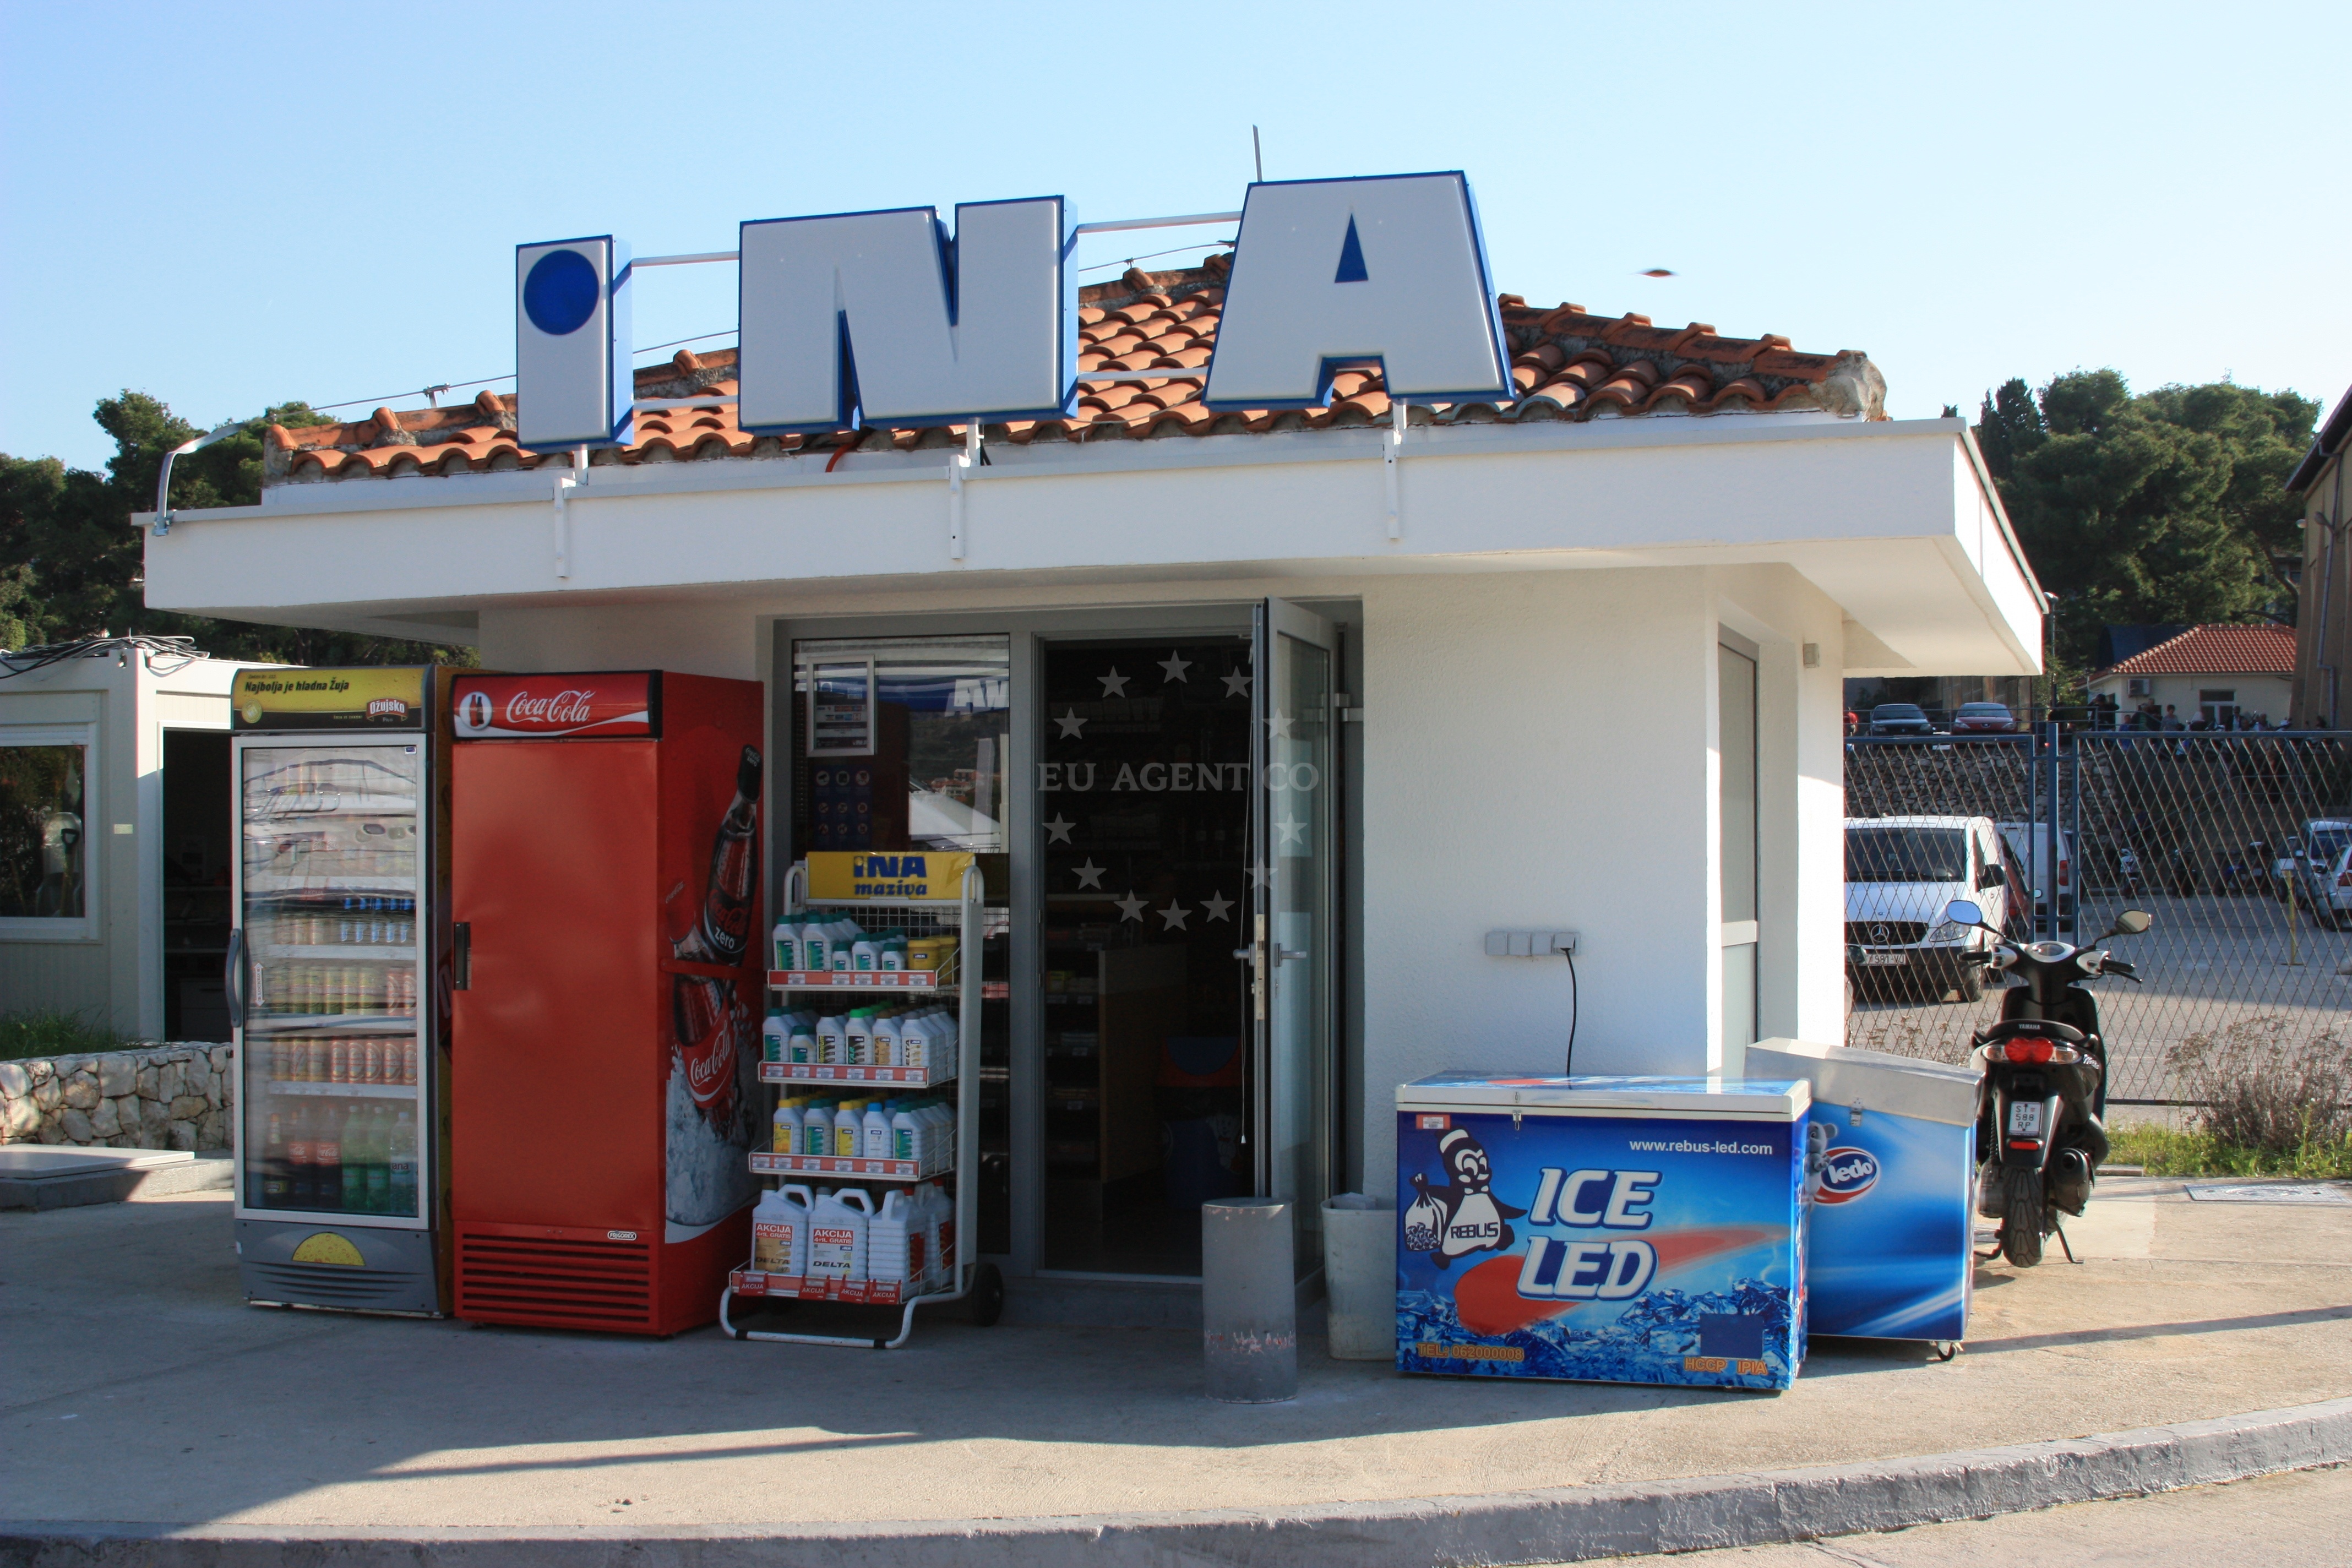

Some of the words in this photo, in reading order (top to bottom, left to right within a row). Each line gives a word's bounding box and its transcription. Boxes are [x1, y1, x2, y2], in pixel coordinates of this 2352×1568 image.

[245, 681, 283, 694] Najbolja
[283, 681, 293, 694] je
[296, 680, 328, 690] hladna
[329, 677, 350, 692] Žuja
[369, 700, 405, 714] Ožujsko
[506, 690, 596, 723] Coca-Cola
[854, 880, 927, 896] maziva
[708, 888, 747, 936] Coca-Cola
[715, 926, 736, 950] zero
[690, 1019, 731, 1088] Coca-Cola
[1629, 1138, 1773, 1155] www.rebus-led.com
[1827, 1159, 1874, 1184] ledo
[1528, 1167, 1663, 1229] ICE
[756, 1224, 792, 1234] AKCIJA
[814, 1229, 852, 1238] AKCIJA
[1450, 1221, 1499, 1240] REBUS
[756, 1257, 790, 1265] DELTA
[1516, 1235, 1659, 1302] LED
[841, 1288, 863, 1297] AKCIJA
[1415, 1342, 1449, 1359] TEL:
[1451, 1344, 1525, 1362] 062000008
[1684, 1358, 1727, 1374] HCCP
[1736, 1359, 1768, 1376] IPIA
